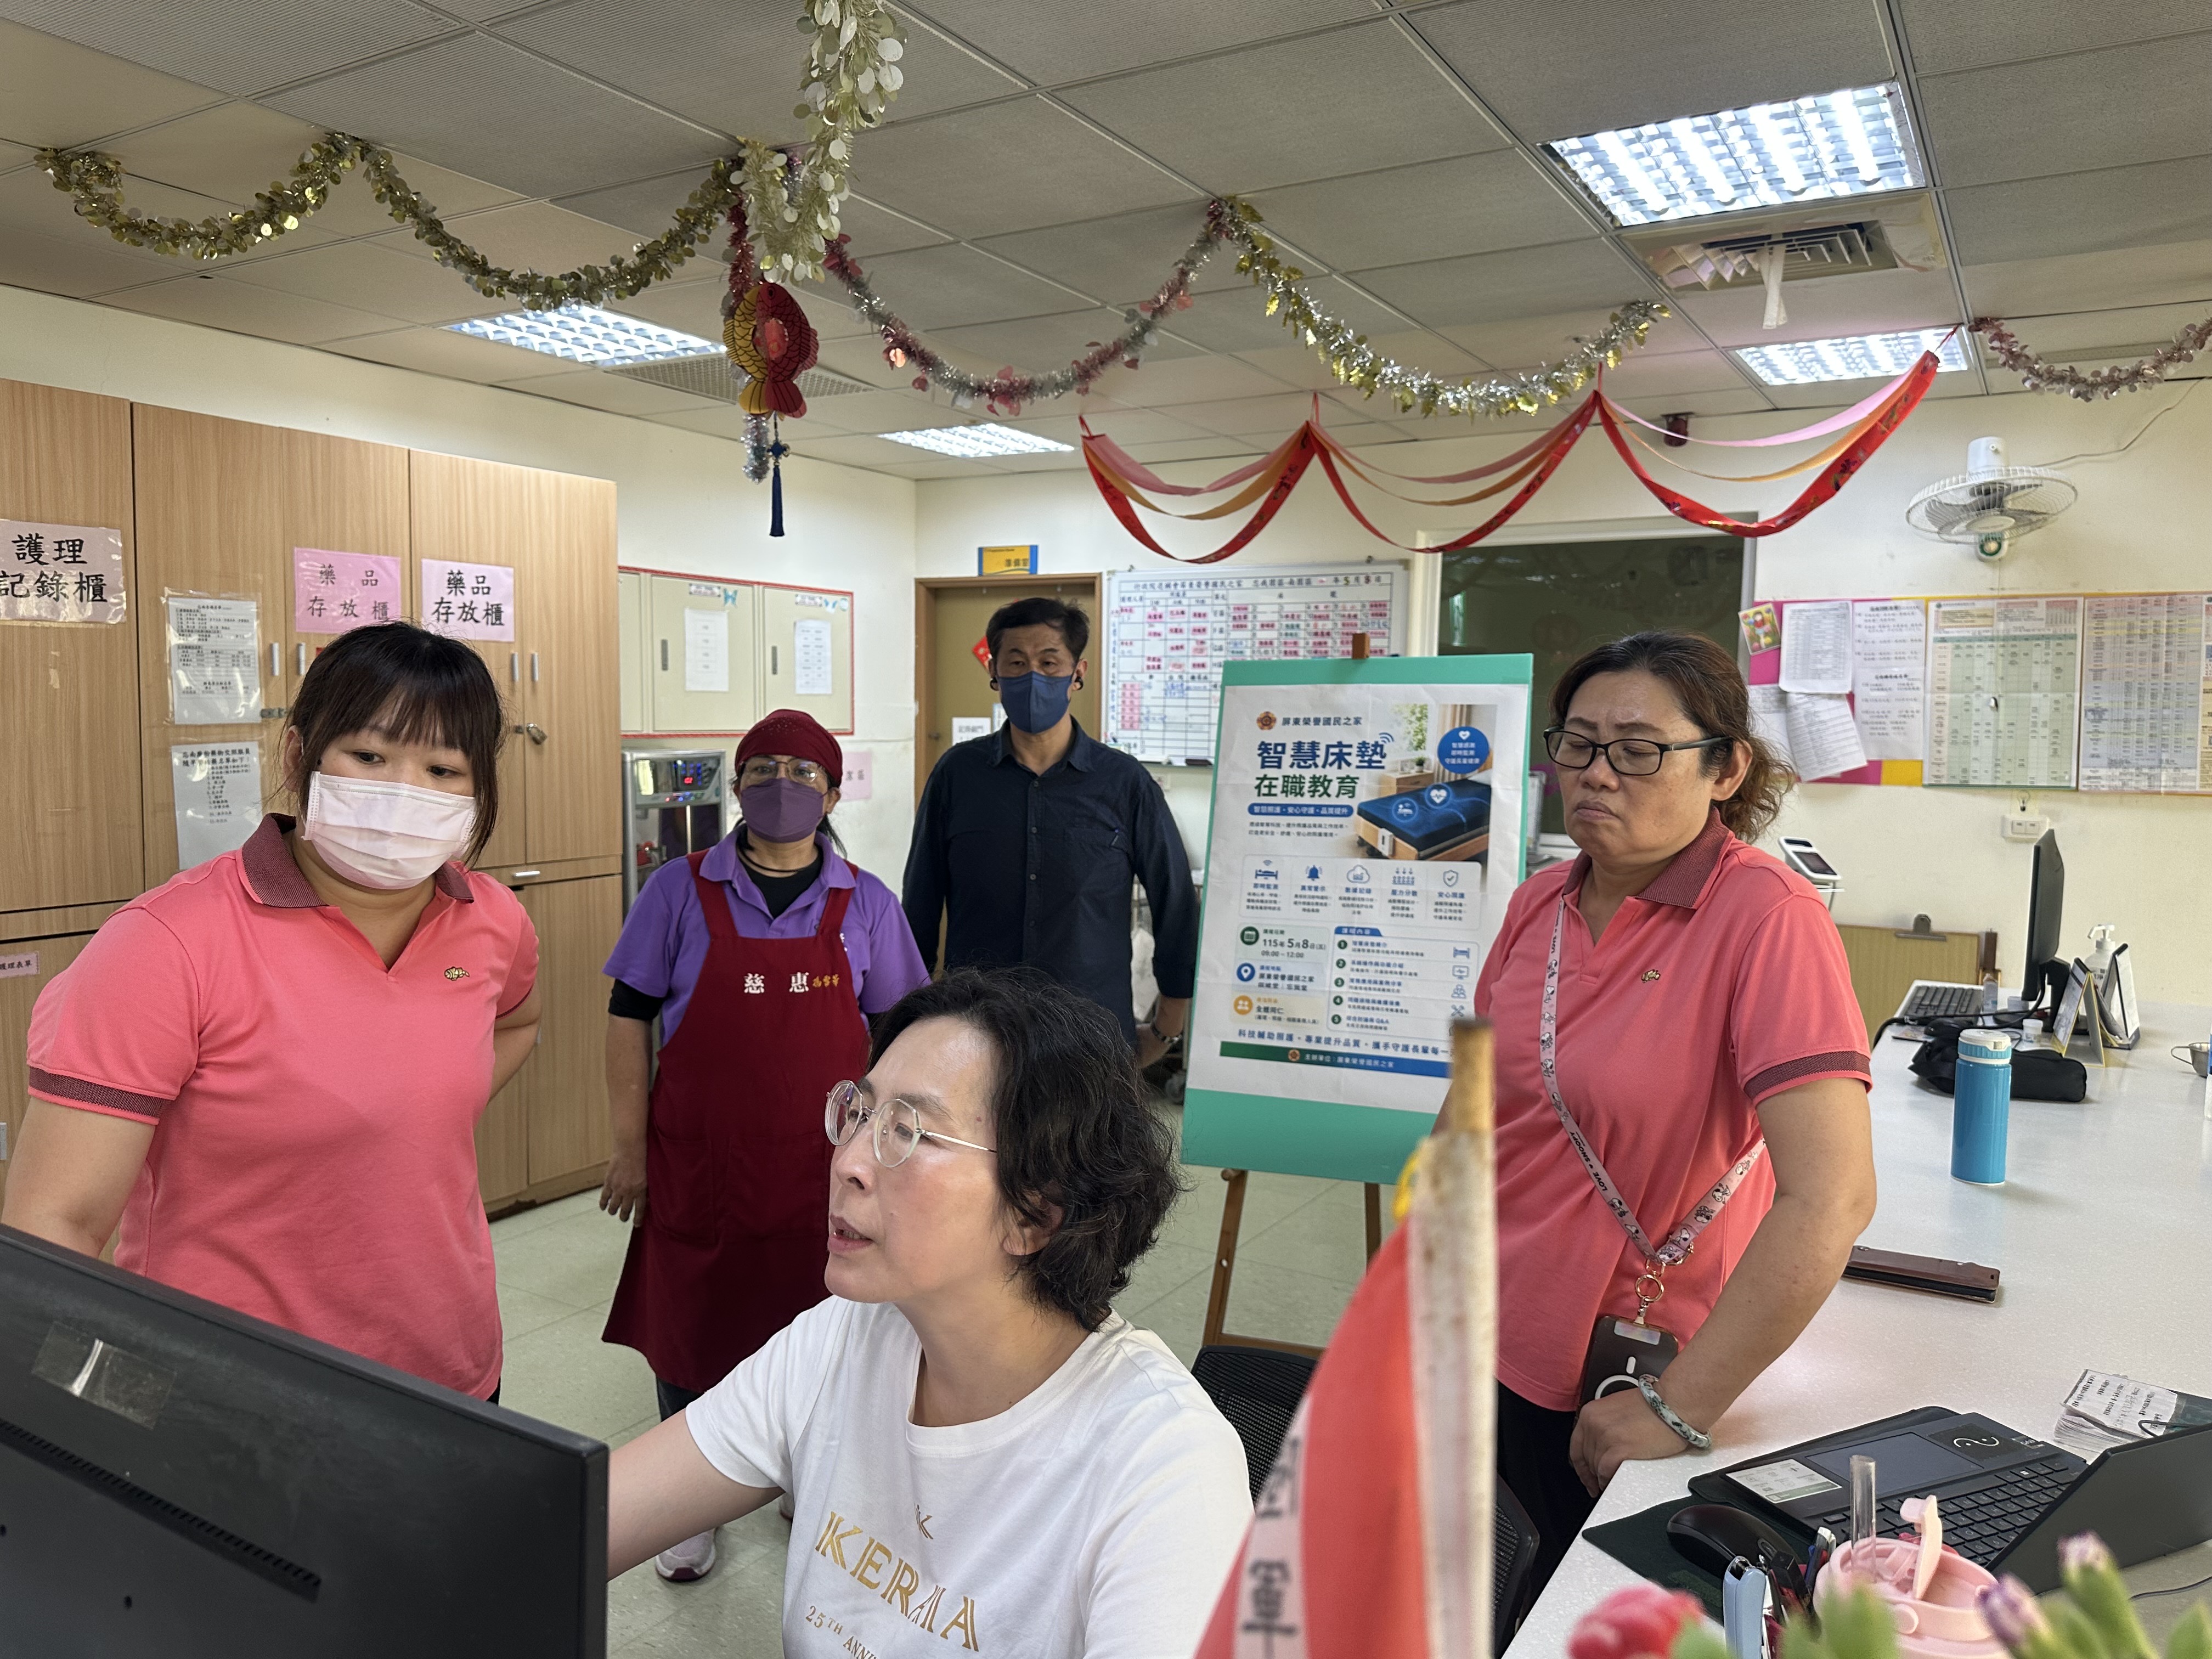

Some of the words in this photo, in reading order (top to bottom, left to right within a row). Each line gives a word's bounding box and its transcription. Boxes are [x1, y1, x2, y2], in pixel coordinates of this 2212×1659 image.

[11, 532, 88, 566] 護理
[0, 569, 108, 603] 記錄櫃
[318, 563, 379, 587] 藥品
[446, 569, 492, 596] 藥品
[307, 595, 389, 623] 存放櫃
[431, 597, 504, 627] 存放櫃
[1282, 716, 1362, 726] 屏東榮譽國民之家
[1257, 741, 1387, 770] 智慧床墊
[1254, 774, 1360, 799] 在職教育
[1570, 1131, 1590, 1163] SNOOPY
[1593, 1172, 1607, 1191] LOVE
[805, 1605, 843, 1635] 25TH
